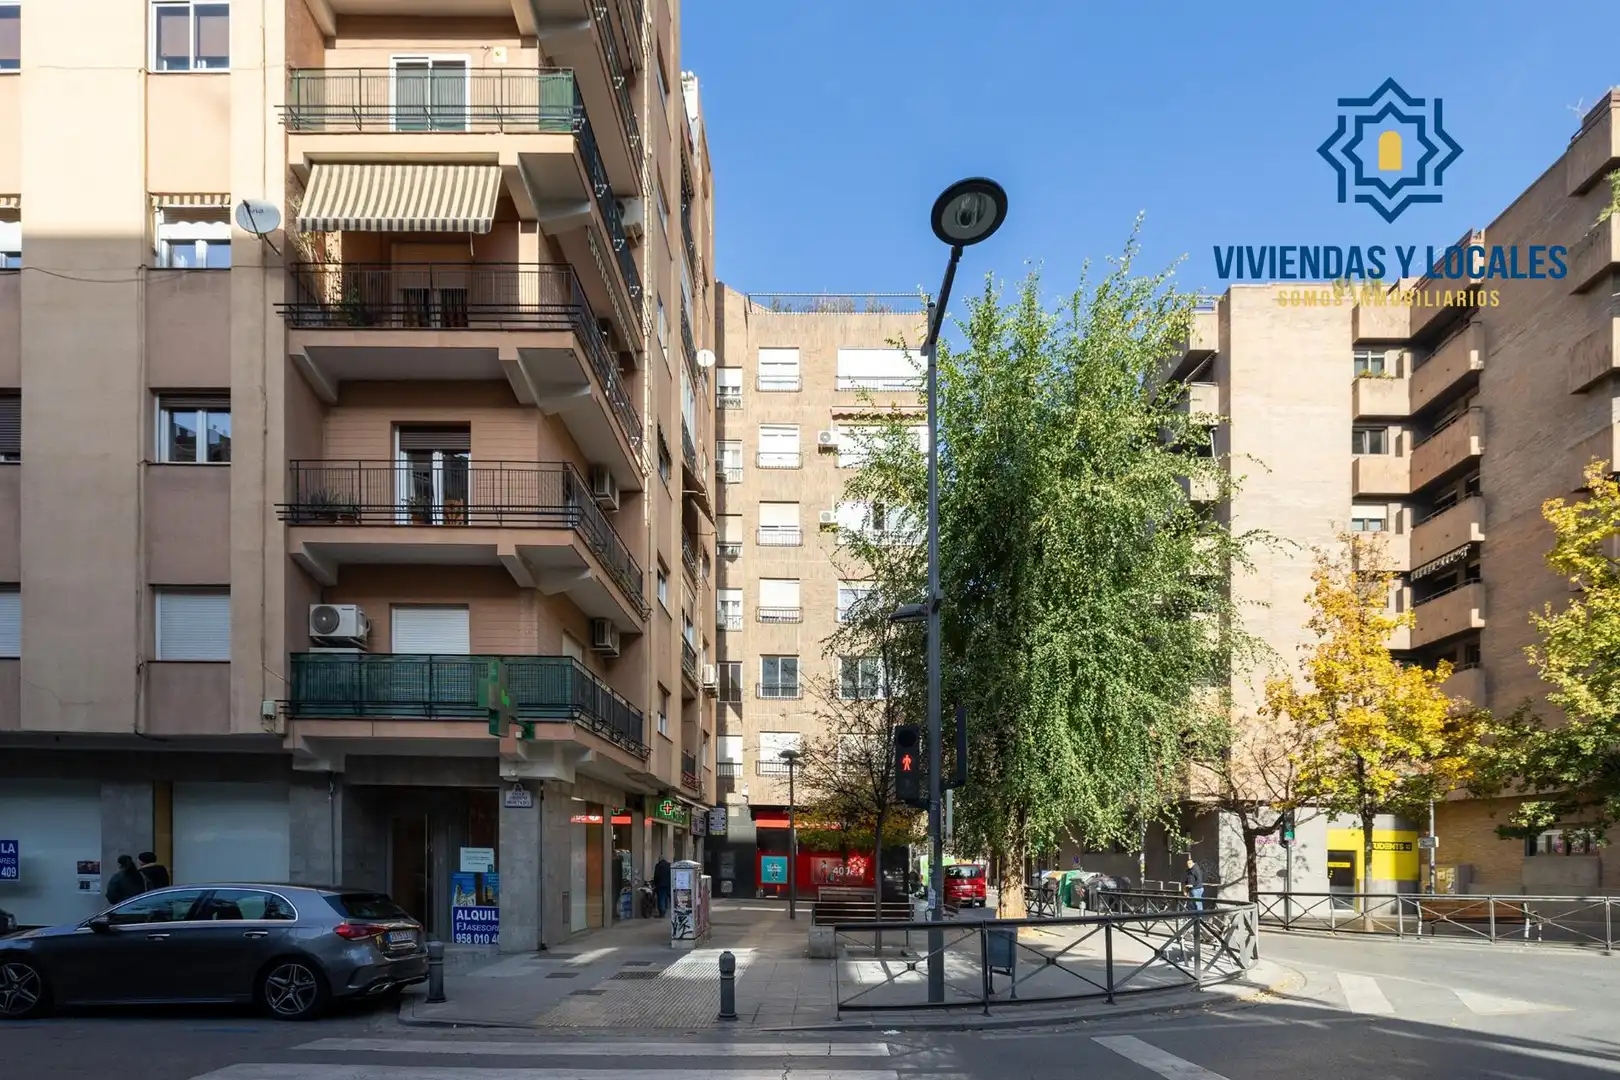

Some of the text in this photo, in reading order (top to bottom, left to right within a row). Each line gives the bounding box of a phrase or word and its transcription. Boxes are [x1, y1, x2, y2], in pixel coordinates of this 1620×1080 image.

[1, 866, 17, 878] 409
[456, 909, 499, 921] ALQUIL
[456, 933, 472, 944] 958
[473, 933, 490, 944] 010
